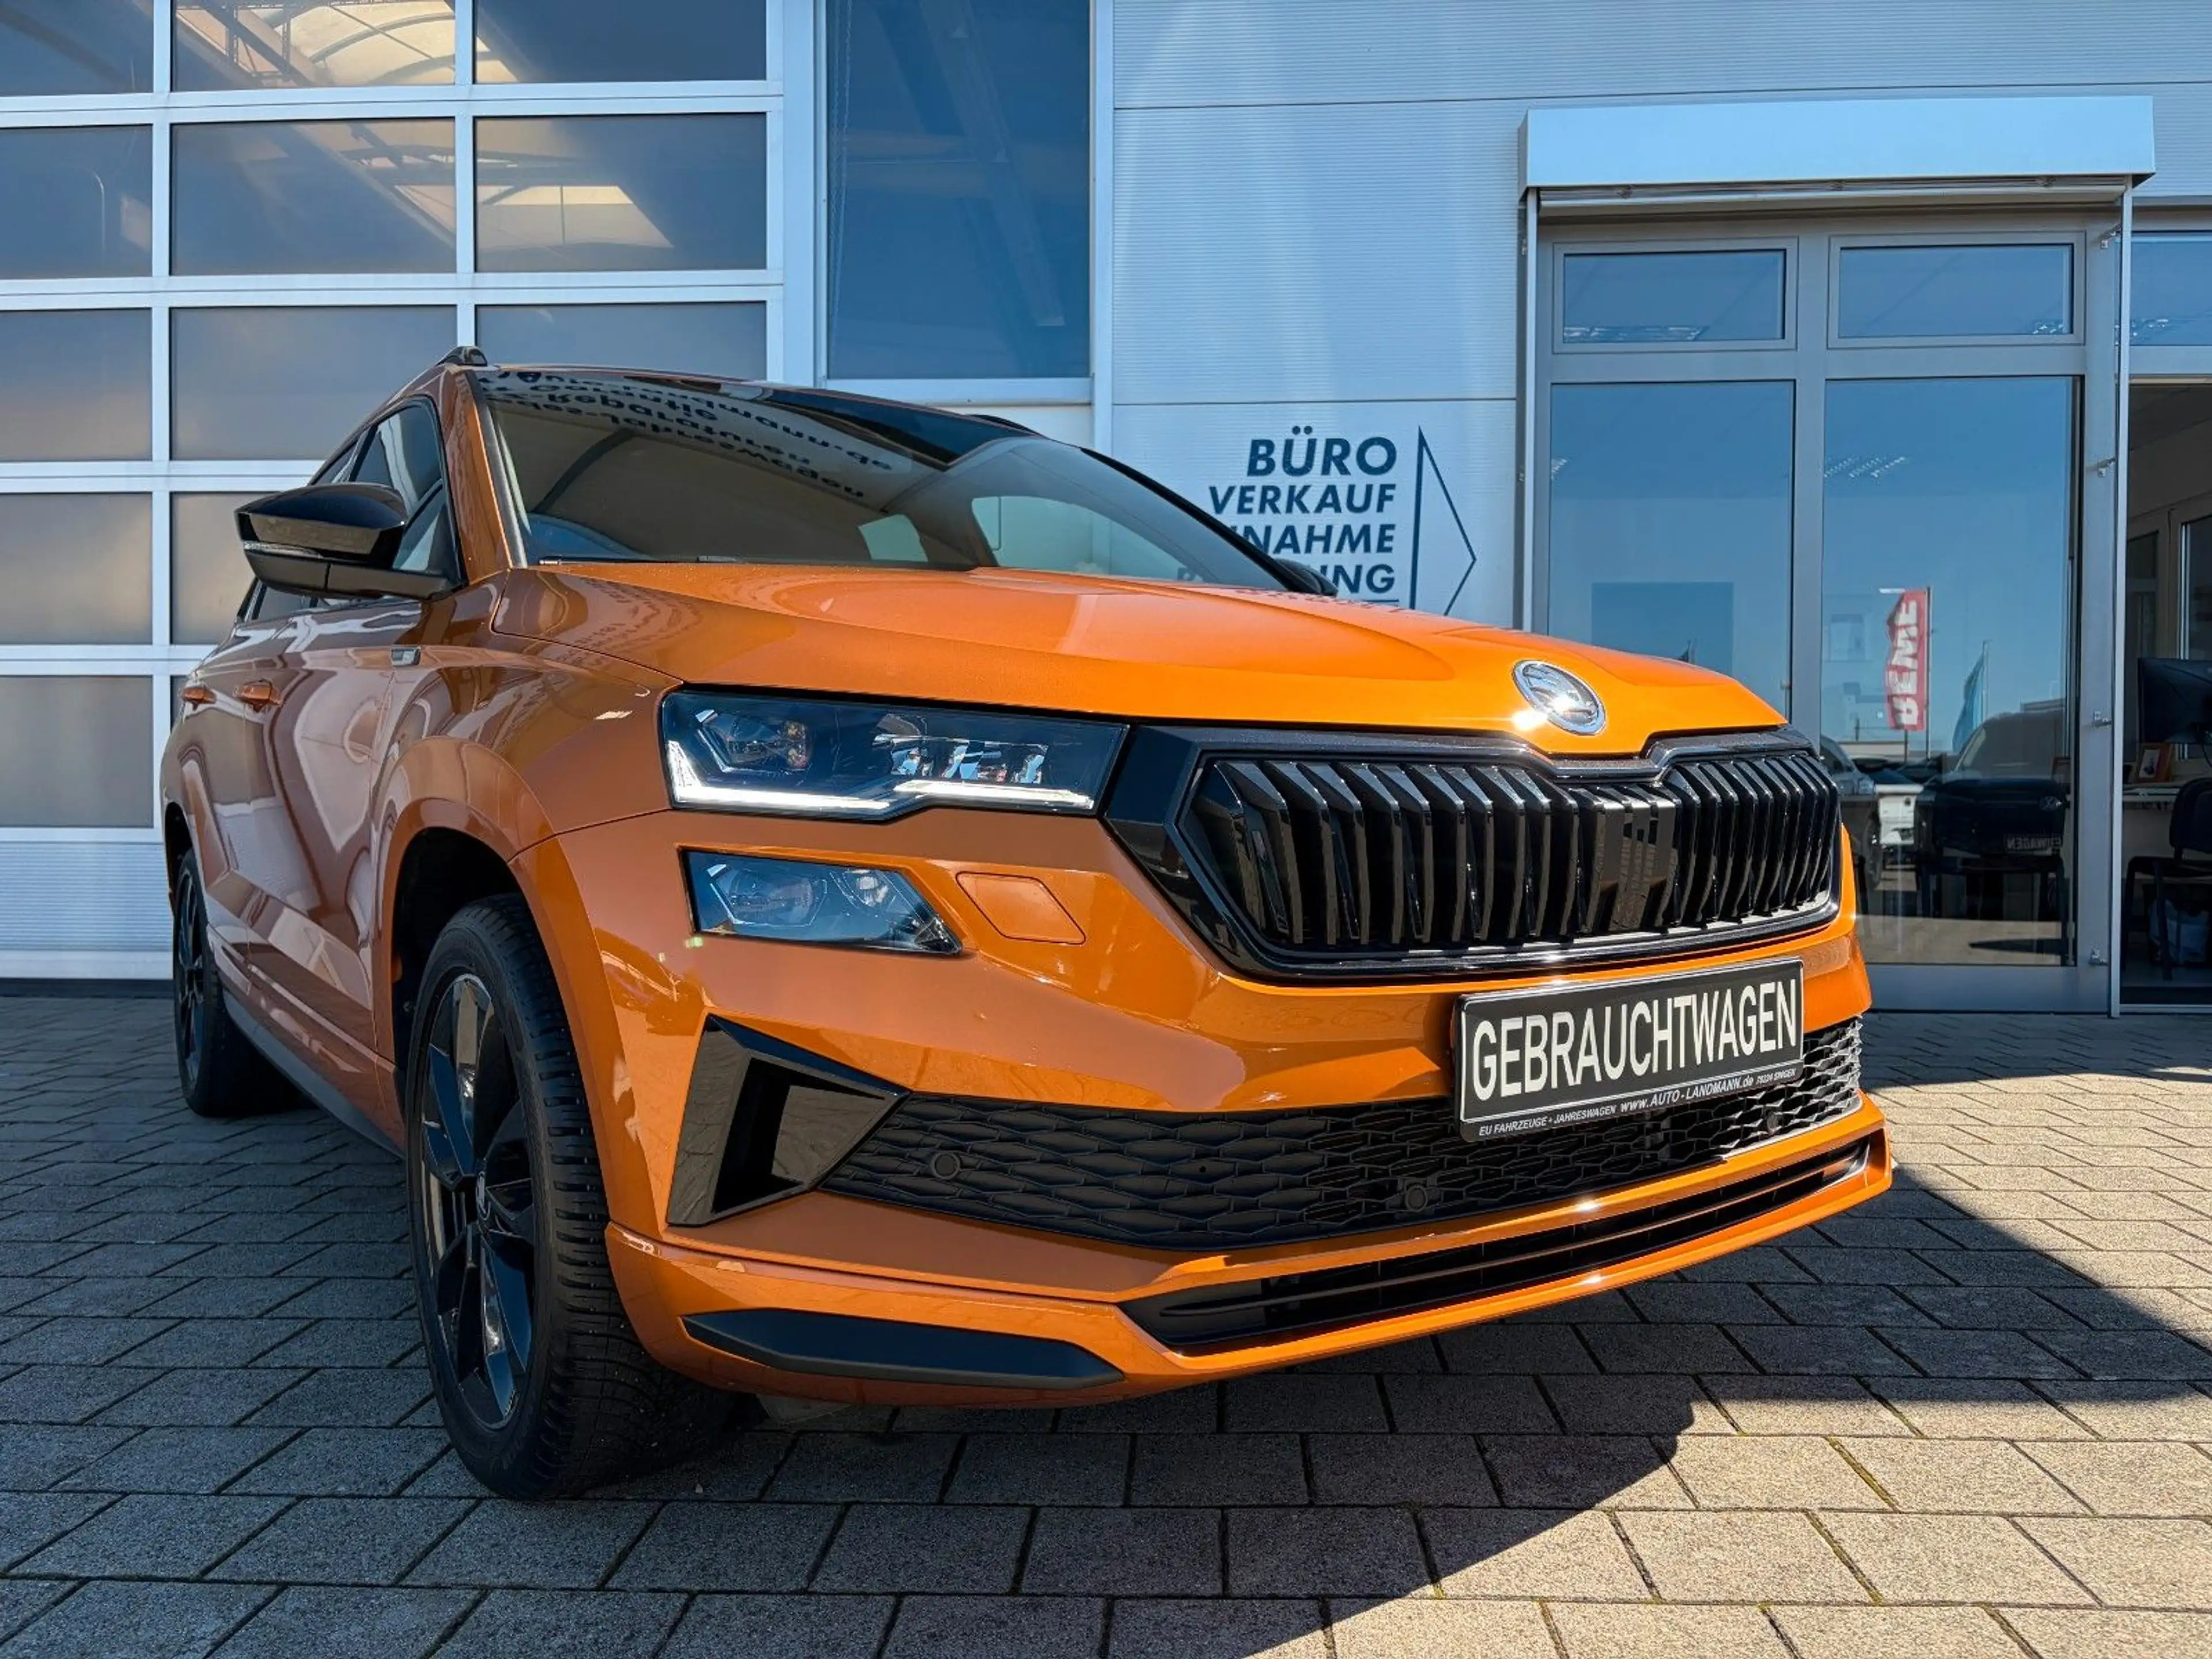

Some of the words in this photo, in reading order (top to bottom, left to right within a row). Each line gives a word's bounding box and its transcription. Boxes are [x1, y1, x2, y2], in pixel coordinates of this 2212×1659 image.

[1247, 426, 1397, 476] BÜRO
[1209, 484, 1397, 515] VERKAUF
[1231, 524, 1396, 554] NAHME
[1473, 979, 1797, 1100] GEBRAUCHTWAGEN
[1479, 1126, 1492, 1137] EU
[1494, 1116, 1548, 1134] FAHRZEUGE
[1554, 1107, 1616, 1124] JAHRESWAGEN
